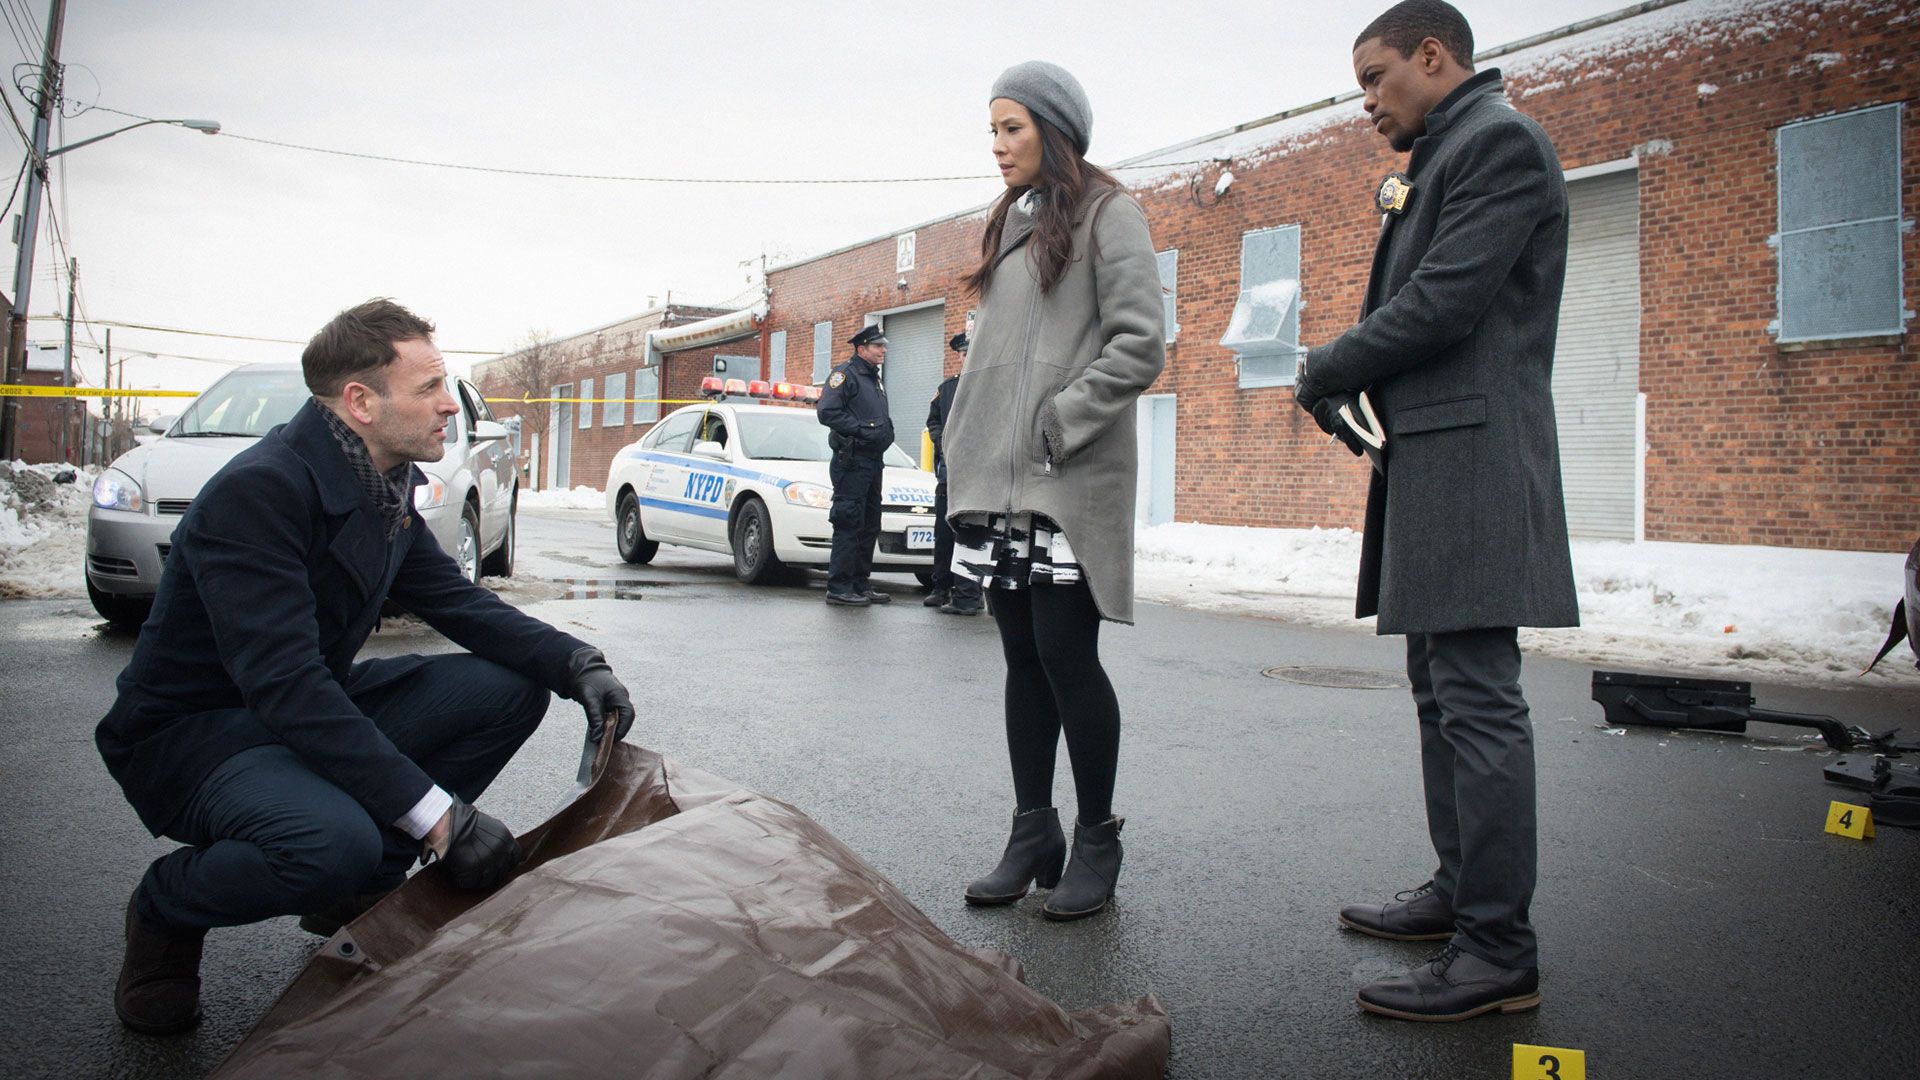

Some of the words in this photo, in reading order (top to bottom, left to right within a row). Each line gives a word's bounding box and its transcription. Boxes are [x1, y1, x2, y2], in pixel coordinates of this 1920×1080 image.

[684, 472, 724, 503] NYPD
[888, 493, 935, 503] POLIC
[912, 531, 936, 542] 772
[1839, 810, 1853, 829] 4
[1539, 1054, 1561, 1080] 3
